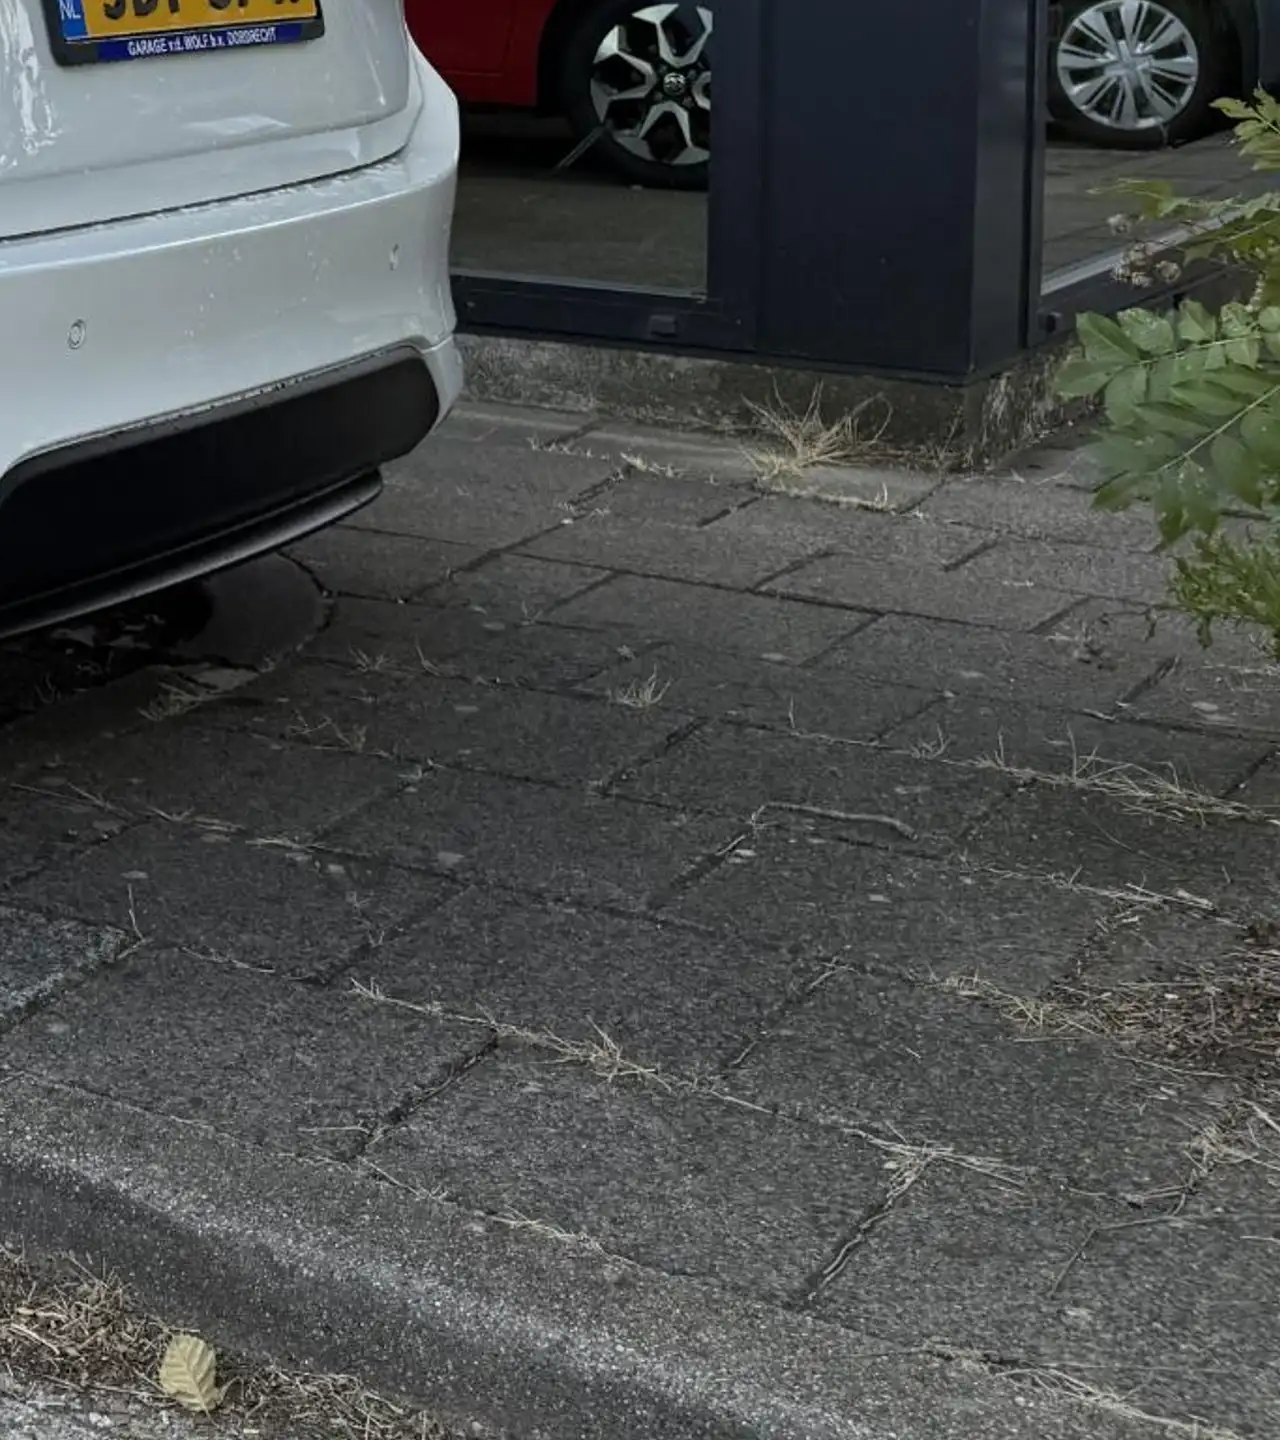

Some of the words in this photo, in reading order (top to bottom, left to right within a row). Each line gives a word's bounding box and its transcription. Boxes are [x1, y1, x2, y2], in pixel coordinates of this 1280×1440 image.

[127, 37, 168, 56] GARAGE
[184, 33, 209, 50] WOLF
[226, 26, 277, 46] DORDRECHT
